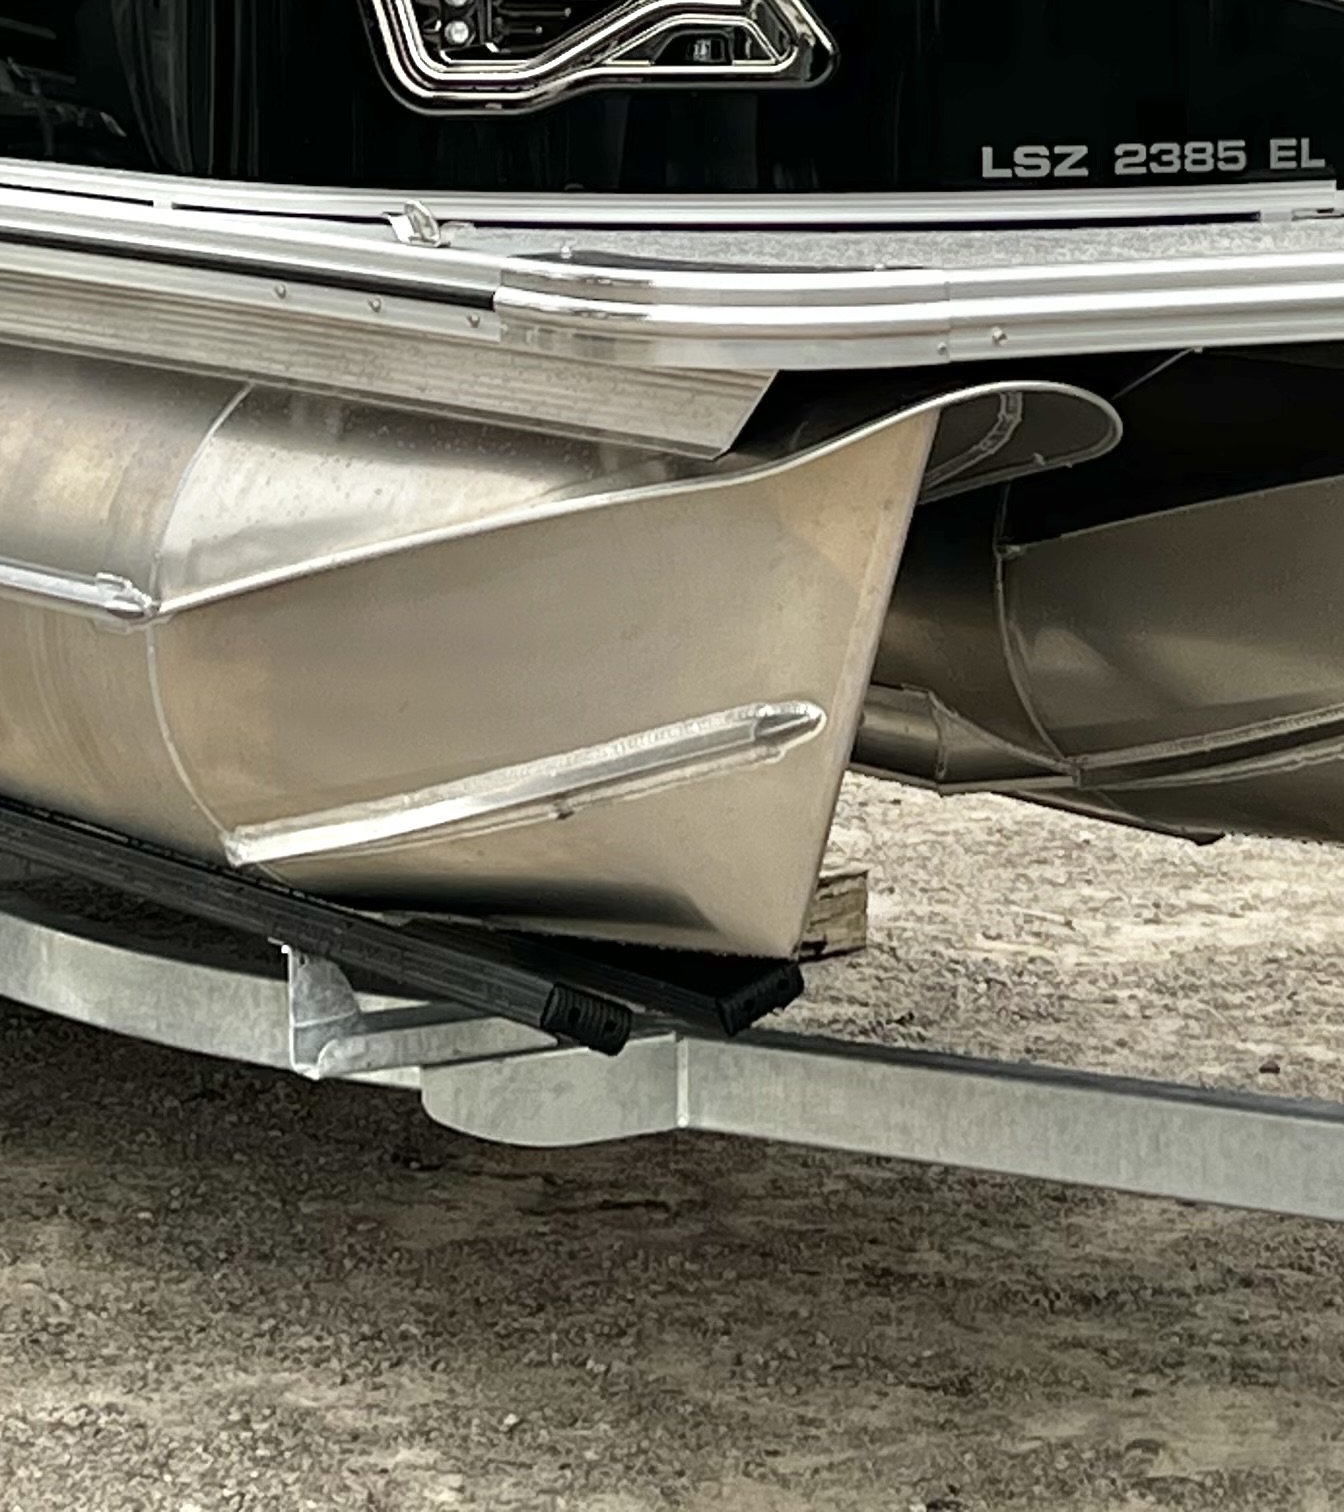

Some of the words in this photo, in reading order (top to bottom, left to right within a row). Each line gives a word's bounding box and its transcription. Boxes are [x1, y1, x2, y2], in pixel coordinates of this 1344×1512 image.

[981, 145, 1089, 178] LSZ
[1113, 140, 1247, 174] 2385
[1269, 137, 1326, 169] EL
